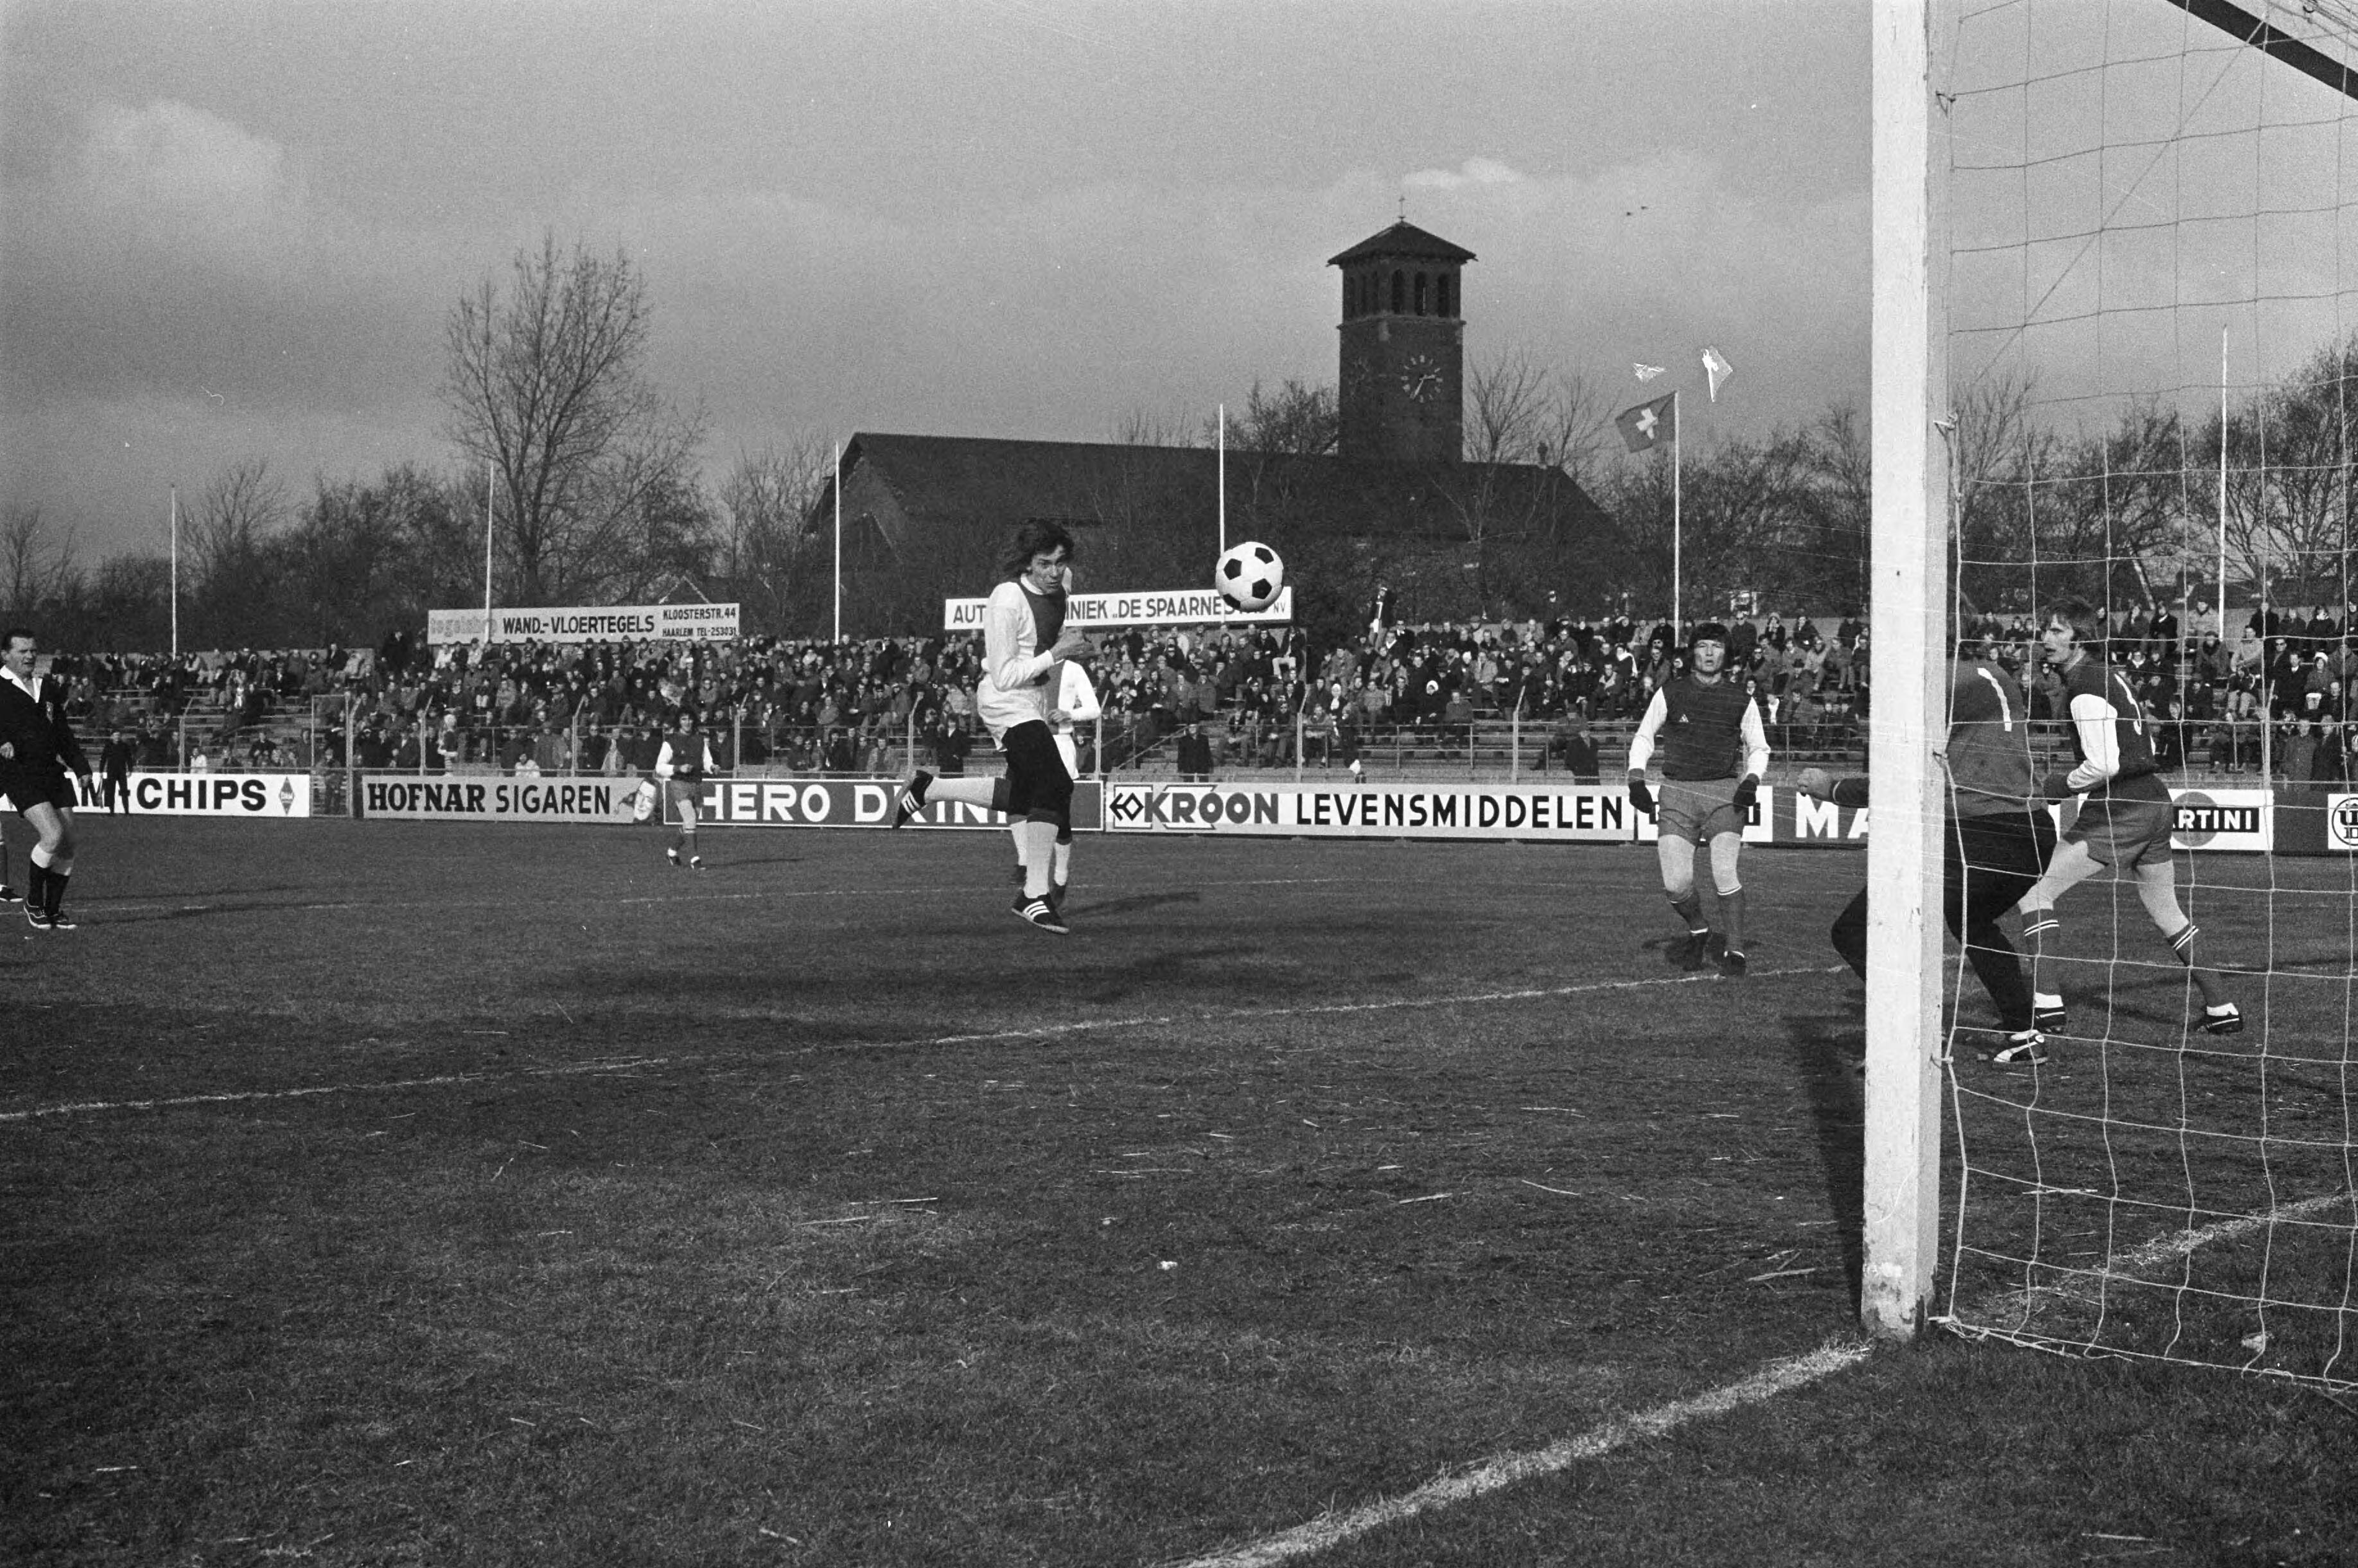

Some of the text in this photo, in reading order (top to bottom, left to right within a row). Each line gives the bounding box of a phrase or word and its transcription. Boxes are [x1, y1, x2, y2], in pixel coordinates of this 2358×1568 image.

[953, 604, 987, 624] AUT
[662, 628, 693, 637] HAARLEM
[367, 783, 610, 814] HOFNAR SIGAREN
[698, 784, 830, 822] HERO
[1144, 792, 1279, 824] KROON
[1297, 793, 1623, 829] LEVENSMIDDELEN
[2172, 809, 2252, 829] RTINI
